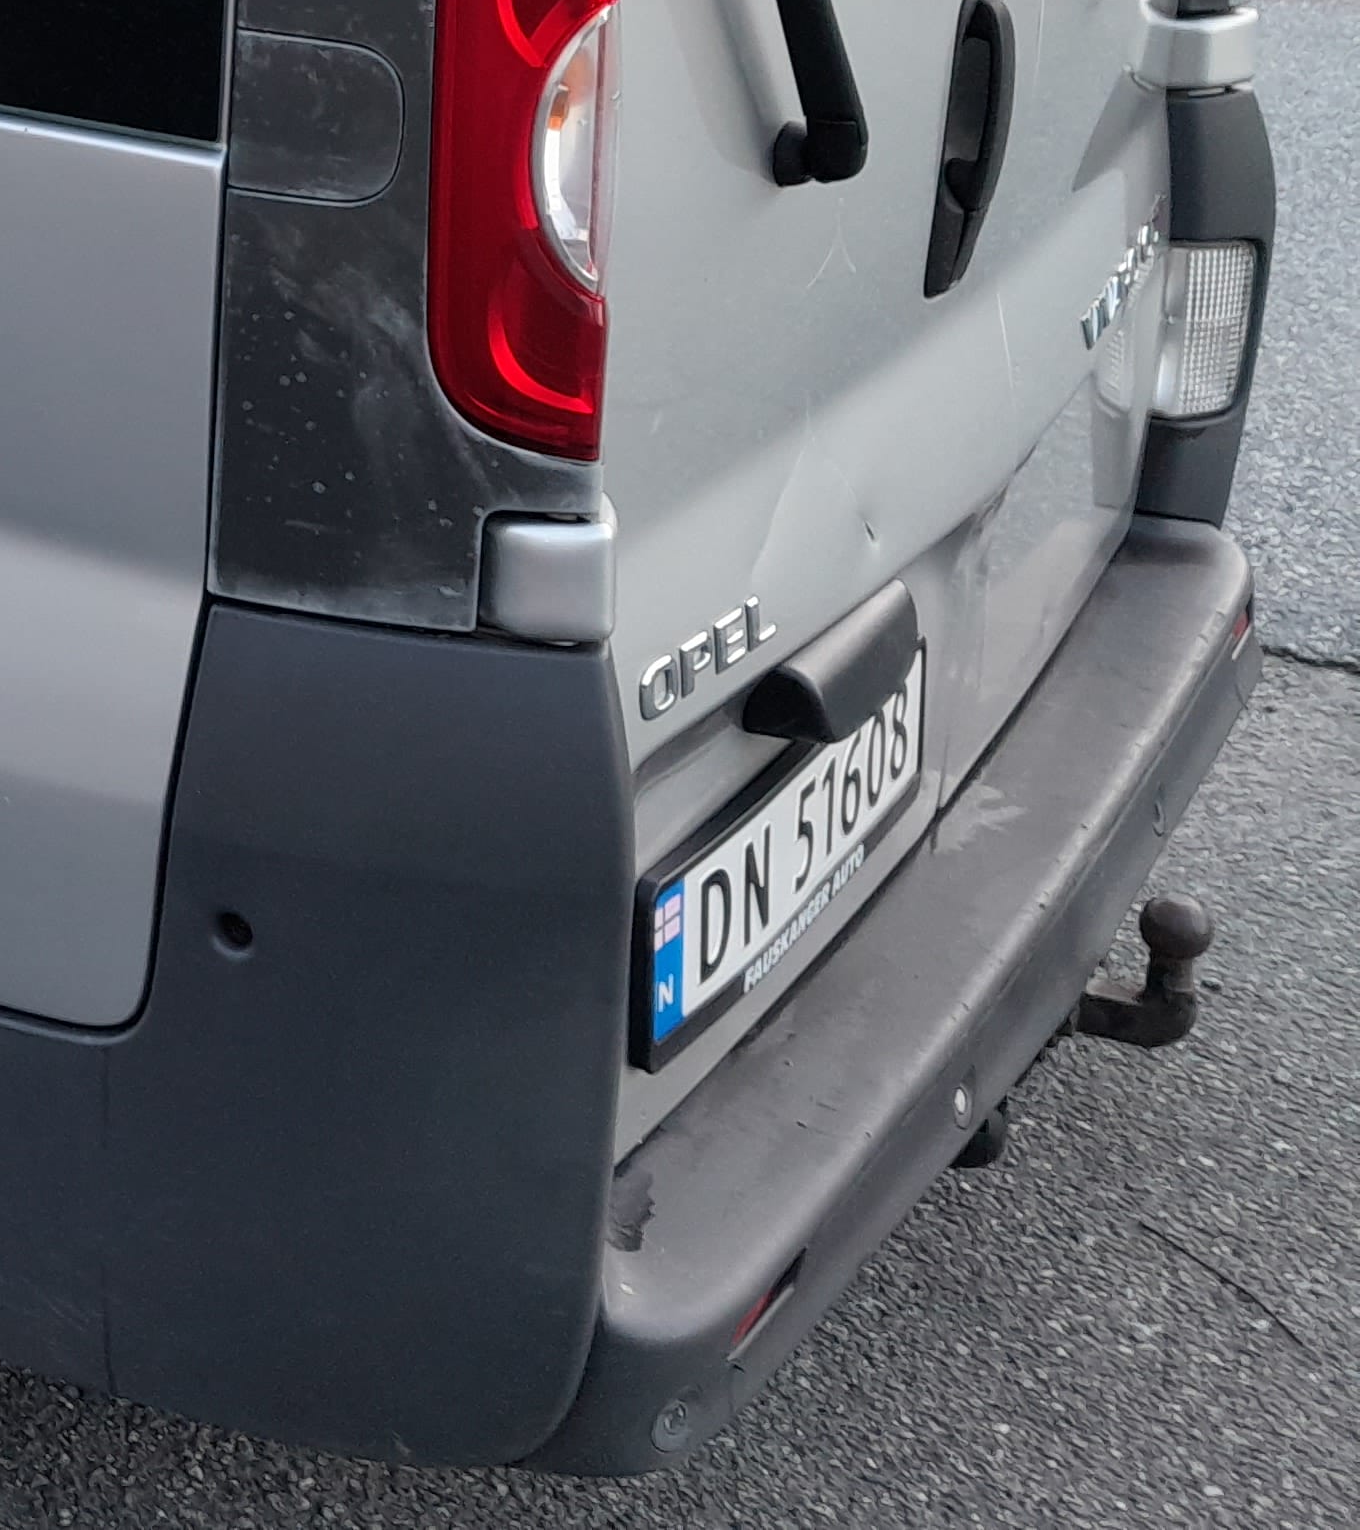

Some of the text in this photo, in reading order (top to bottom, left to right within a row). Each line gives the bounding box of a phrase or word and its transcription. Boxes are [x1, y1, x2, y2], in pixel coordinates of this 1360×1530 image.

[639, 595, 777, 721] OPEL
[699, 678, 908, 984] DN 51608
[742, 842, 865, 994] FAUSKANGER AUTO
[657, 973, 674, 1013] N
